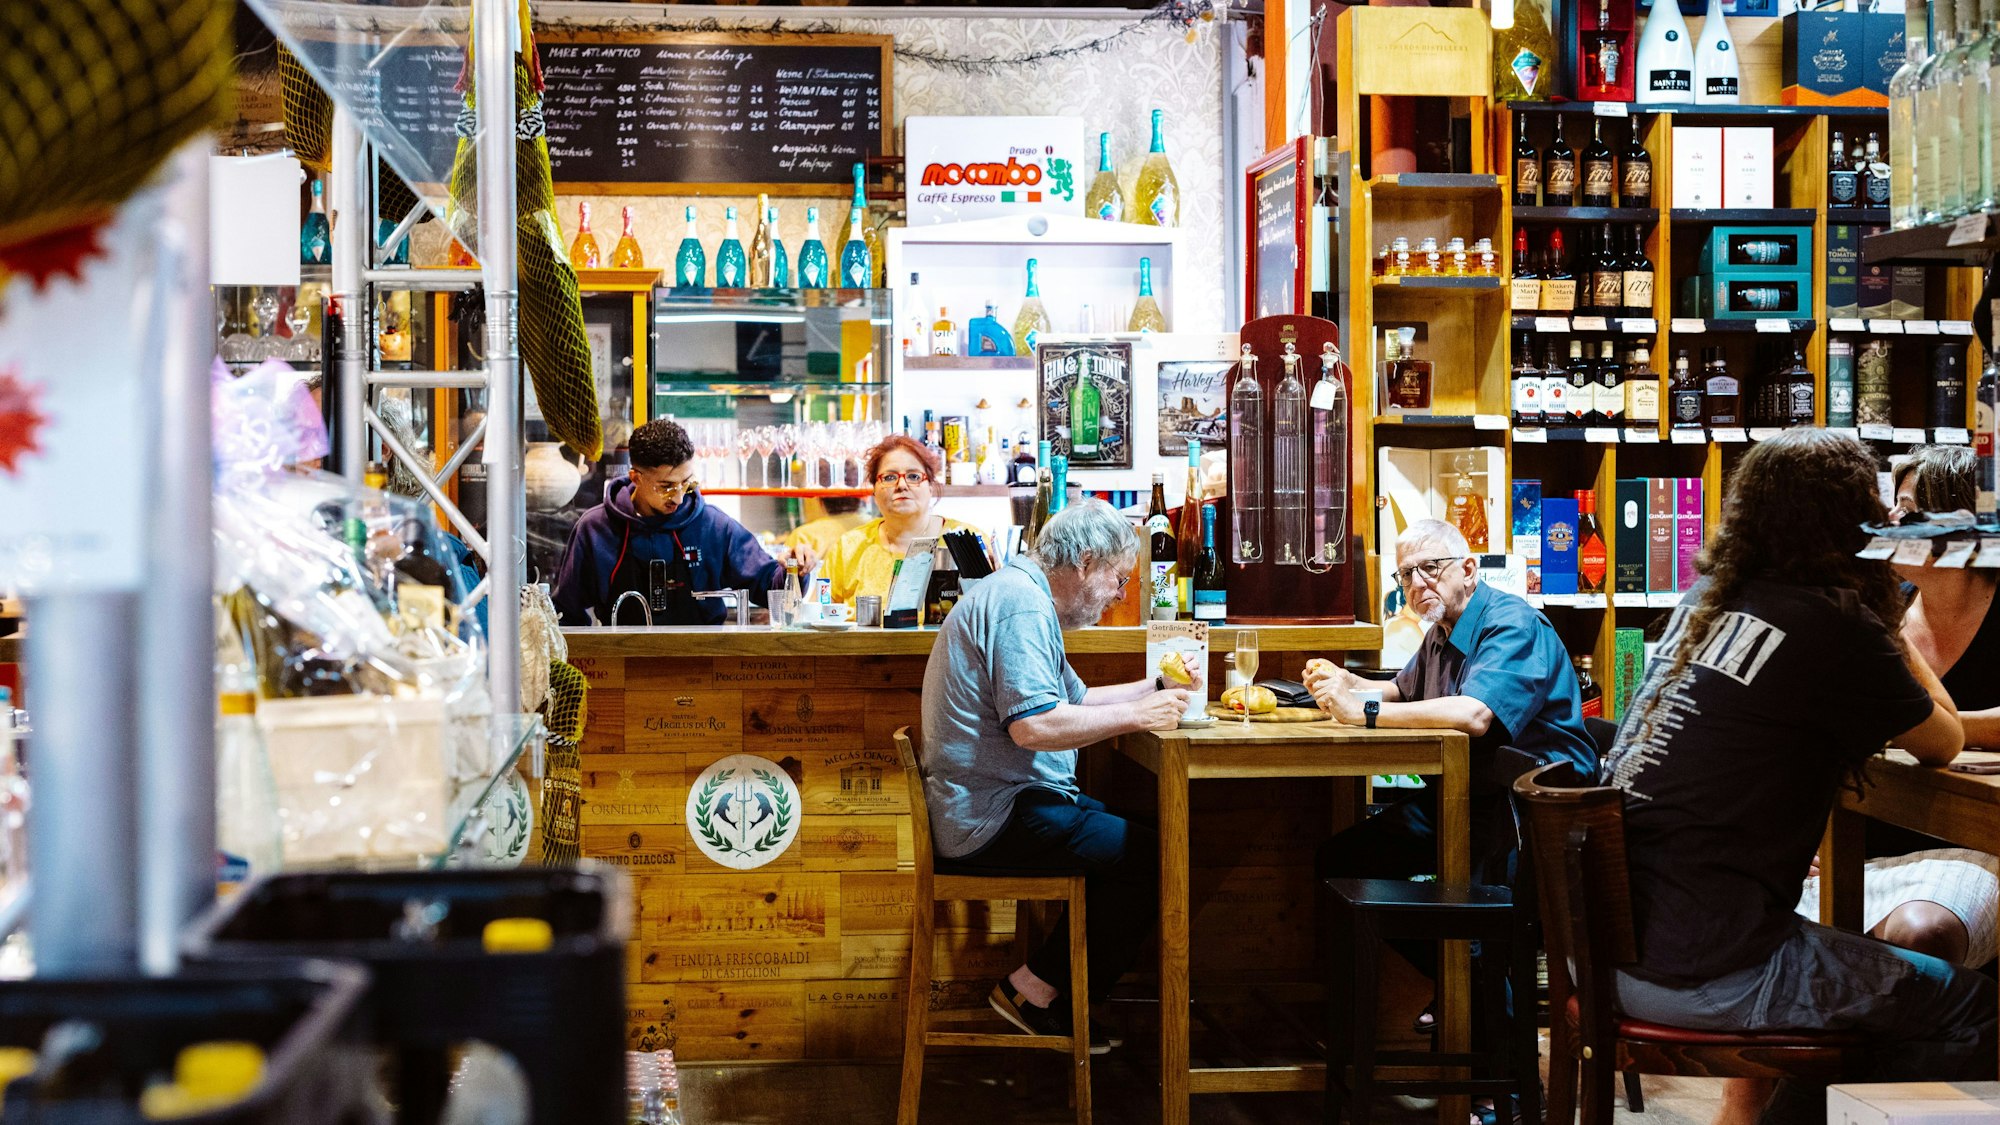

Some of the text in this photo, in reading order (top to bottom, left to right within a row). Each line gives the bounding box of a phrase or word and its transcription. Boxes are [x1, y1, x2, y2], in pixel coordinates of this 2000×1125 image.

[548, 48, 641, 58] MARE ATLANTICO
[1653, 79, 1676, 87] SAINT
[779, 120, 835, 136] Champagner
[1009, 145, 1037, 155] Drago
[921, 157, 1042, 186] mocambo
[1551, 168, 1575, 181] 1776
[1588, 168, 1612, 181] 1776
[1624, 168, 1650, 182] 1776
[917, 192, 996, 204] Caffè Espresso
[1043, 357, 1066, 388] GIN
[1092, 355, 1127, 385] TONIC
[1657, 527, 1665, 535] 12
[1685, 527, 1693, 535] 15
[1151, 624, 1187, 632] Getränke
[740, 661, 787, 670] FATTORIA
[715, 671, 814, 682] POGGIO GAGLIARDO
[707, 716, 726, 731] ROI
[824, 751, 898, 767] MEGAS OENOS
[591, 804, 661, 815] ORNELLAIA
[595, 854, 676, 866] BRUNO GIACOSA
[672, 951, 810, 968] TENUTA FRESCOBALDI
[702, 966, 781, 979] DI CASTIGLIONI
